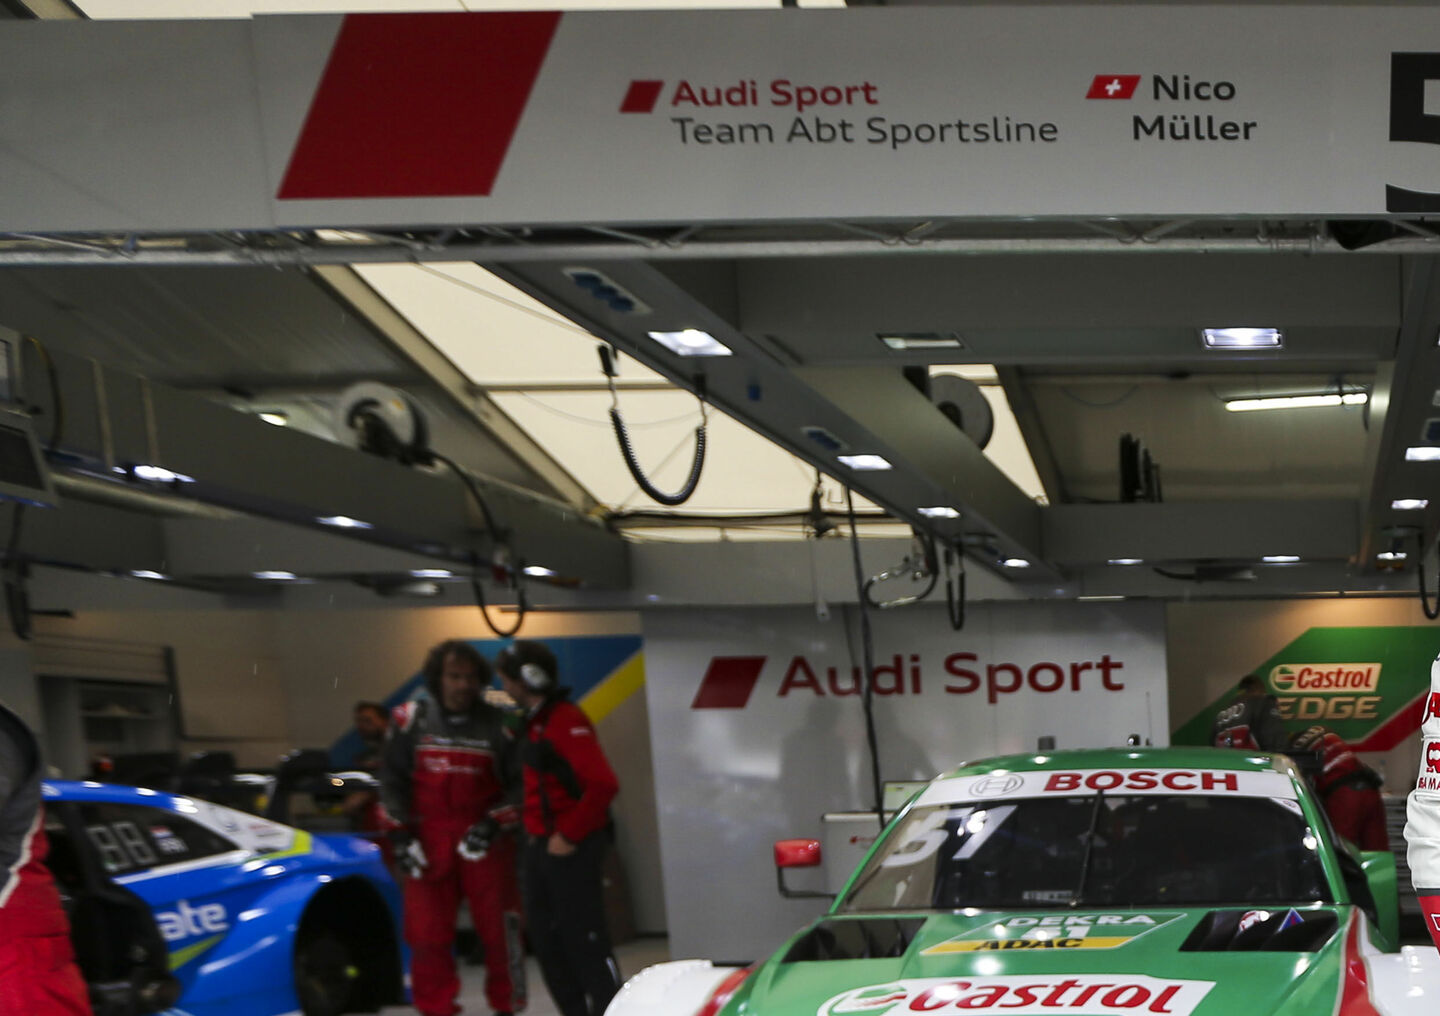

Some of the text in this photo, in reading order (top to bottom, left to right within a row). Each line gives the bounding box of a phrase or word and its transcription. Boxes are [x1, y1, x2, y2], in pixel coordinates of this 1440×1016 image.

[671, 79, 879, 112] Audi Sport
[1153, 74, 1236, 101] Nico
[671, 115, 1059, 150] Team Abt Sportsline
[1131, 113, 1258, 142] Müller
[776, 652, 1126, 704] Audi Sport
[1297, 667, 1373, 689] Castrol
[1276, 696, 1383, 720] EDGE
[1043, 770, 1239, 793] BOSCH
[1006, 914, 1157, 927] DEKRA
[974, 937, 1085, 951] ADAC
[907, 978, 1184, 1015] Castrol
